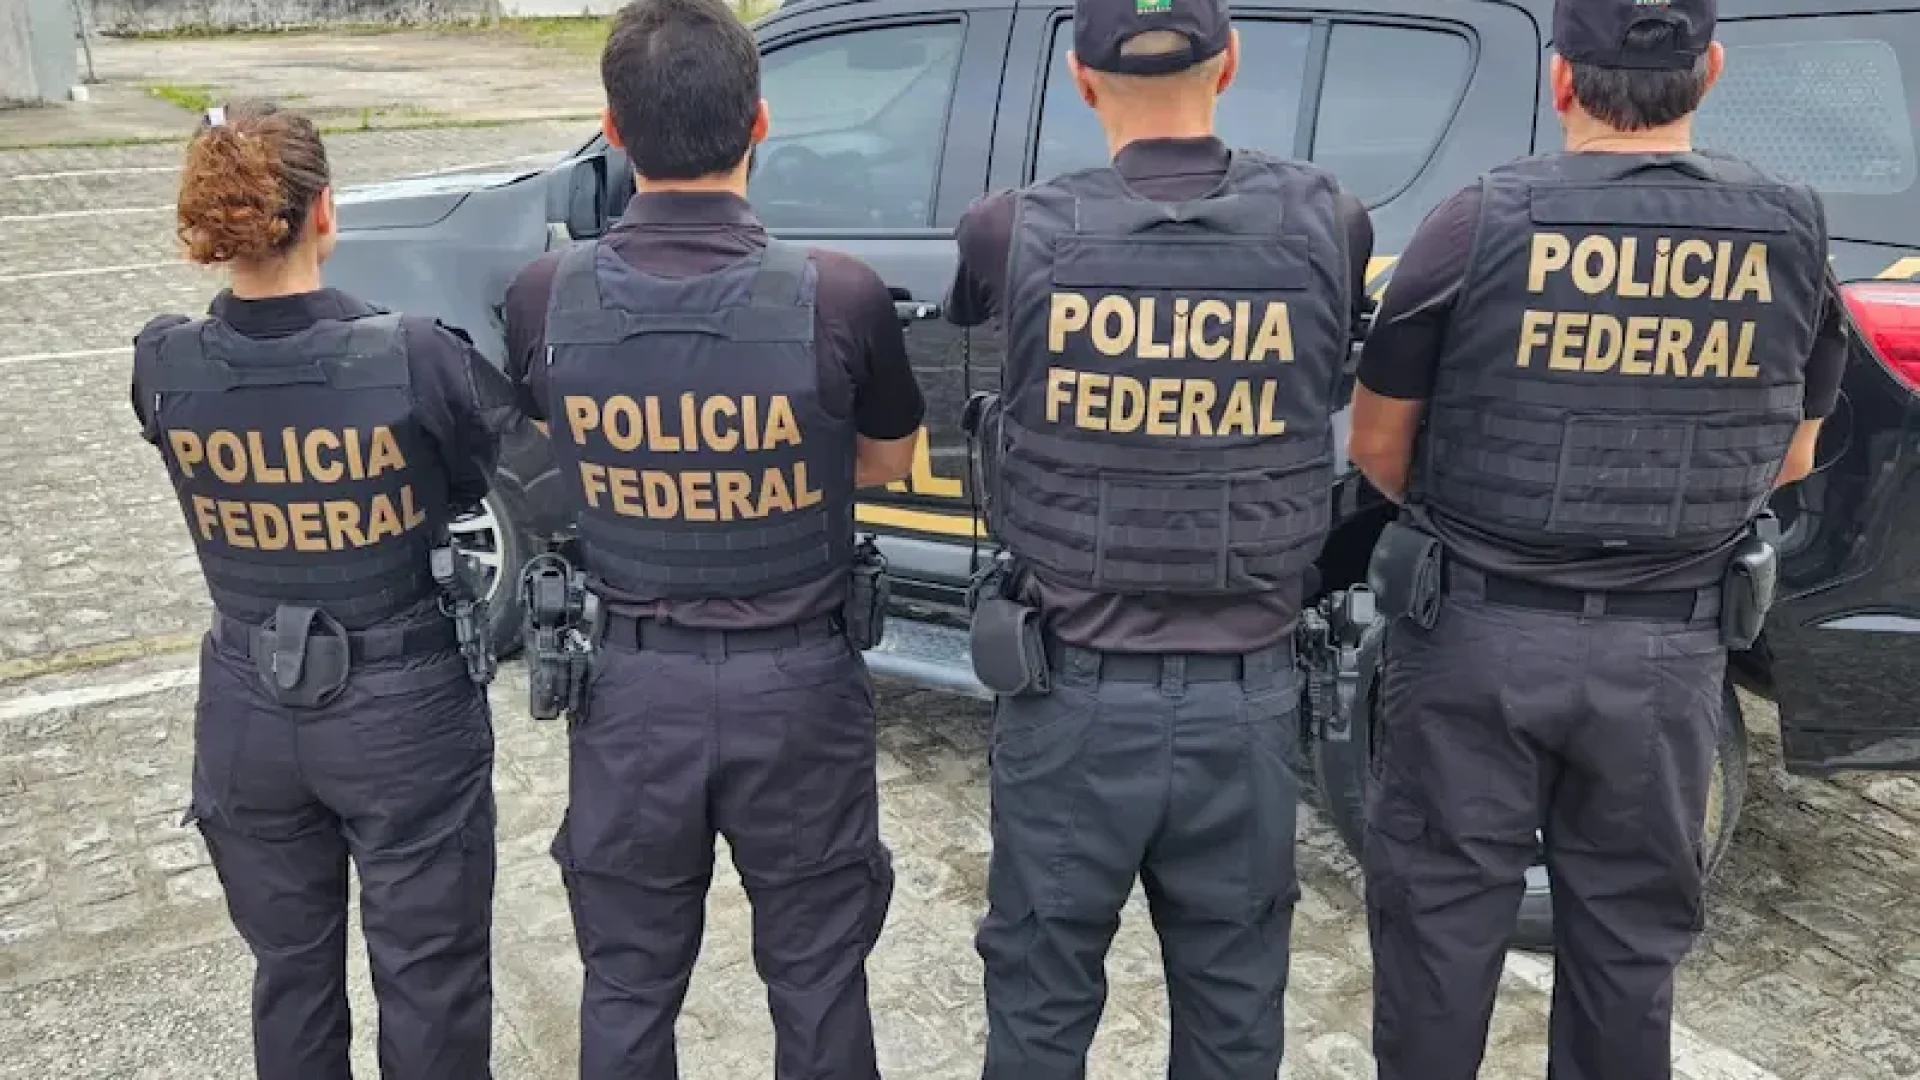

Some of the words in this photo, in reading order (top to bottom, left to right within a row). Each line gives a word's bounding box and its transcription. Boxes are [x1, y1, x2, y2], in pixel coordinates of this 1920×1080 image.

[1516, 309, 1760, 378] FEDERAL
[563, 391, 802, 451] POLÍCIA
[1045, 367, 1286, 435] FEDERAL
[168, 426, 406, 483] POLÍCIA
[192, 484, 426, 550] FEDERAL
[579, 460, 824, 521] FEDERAL
